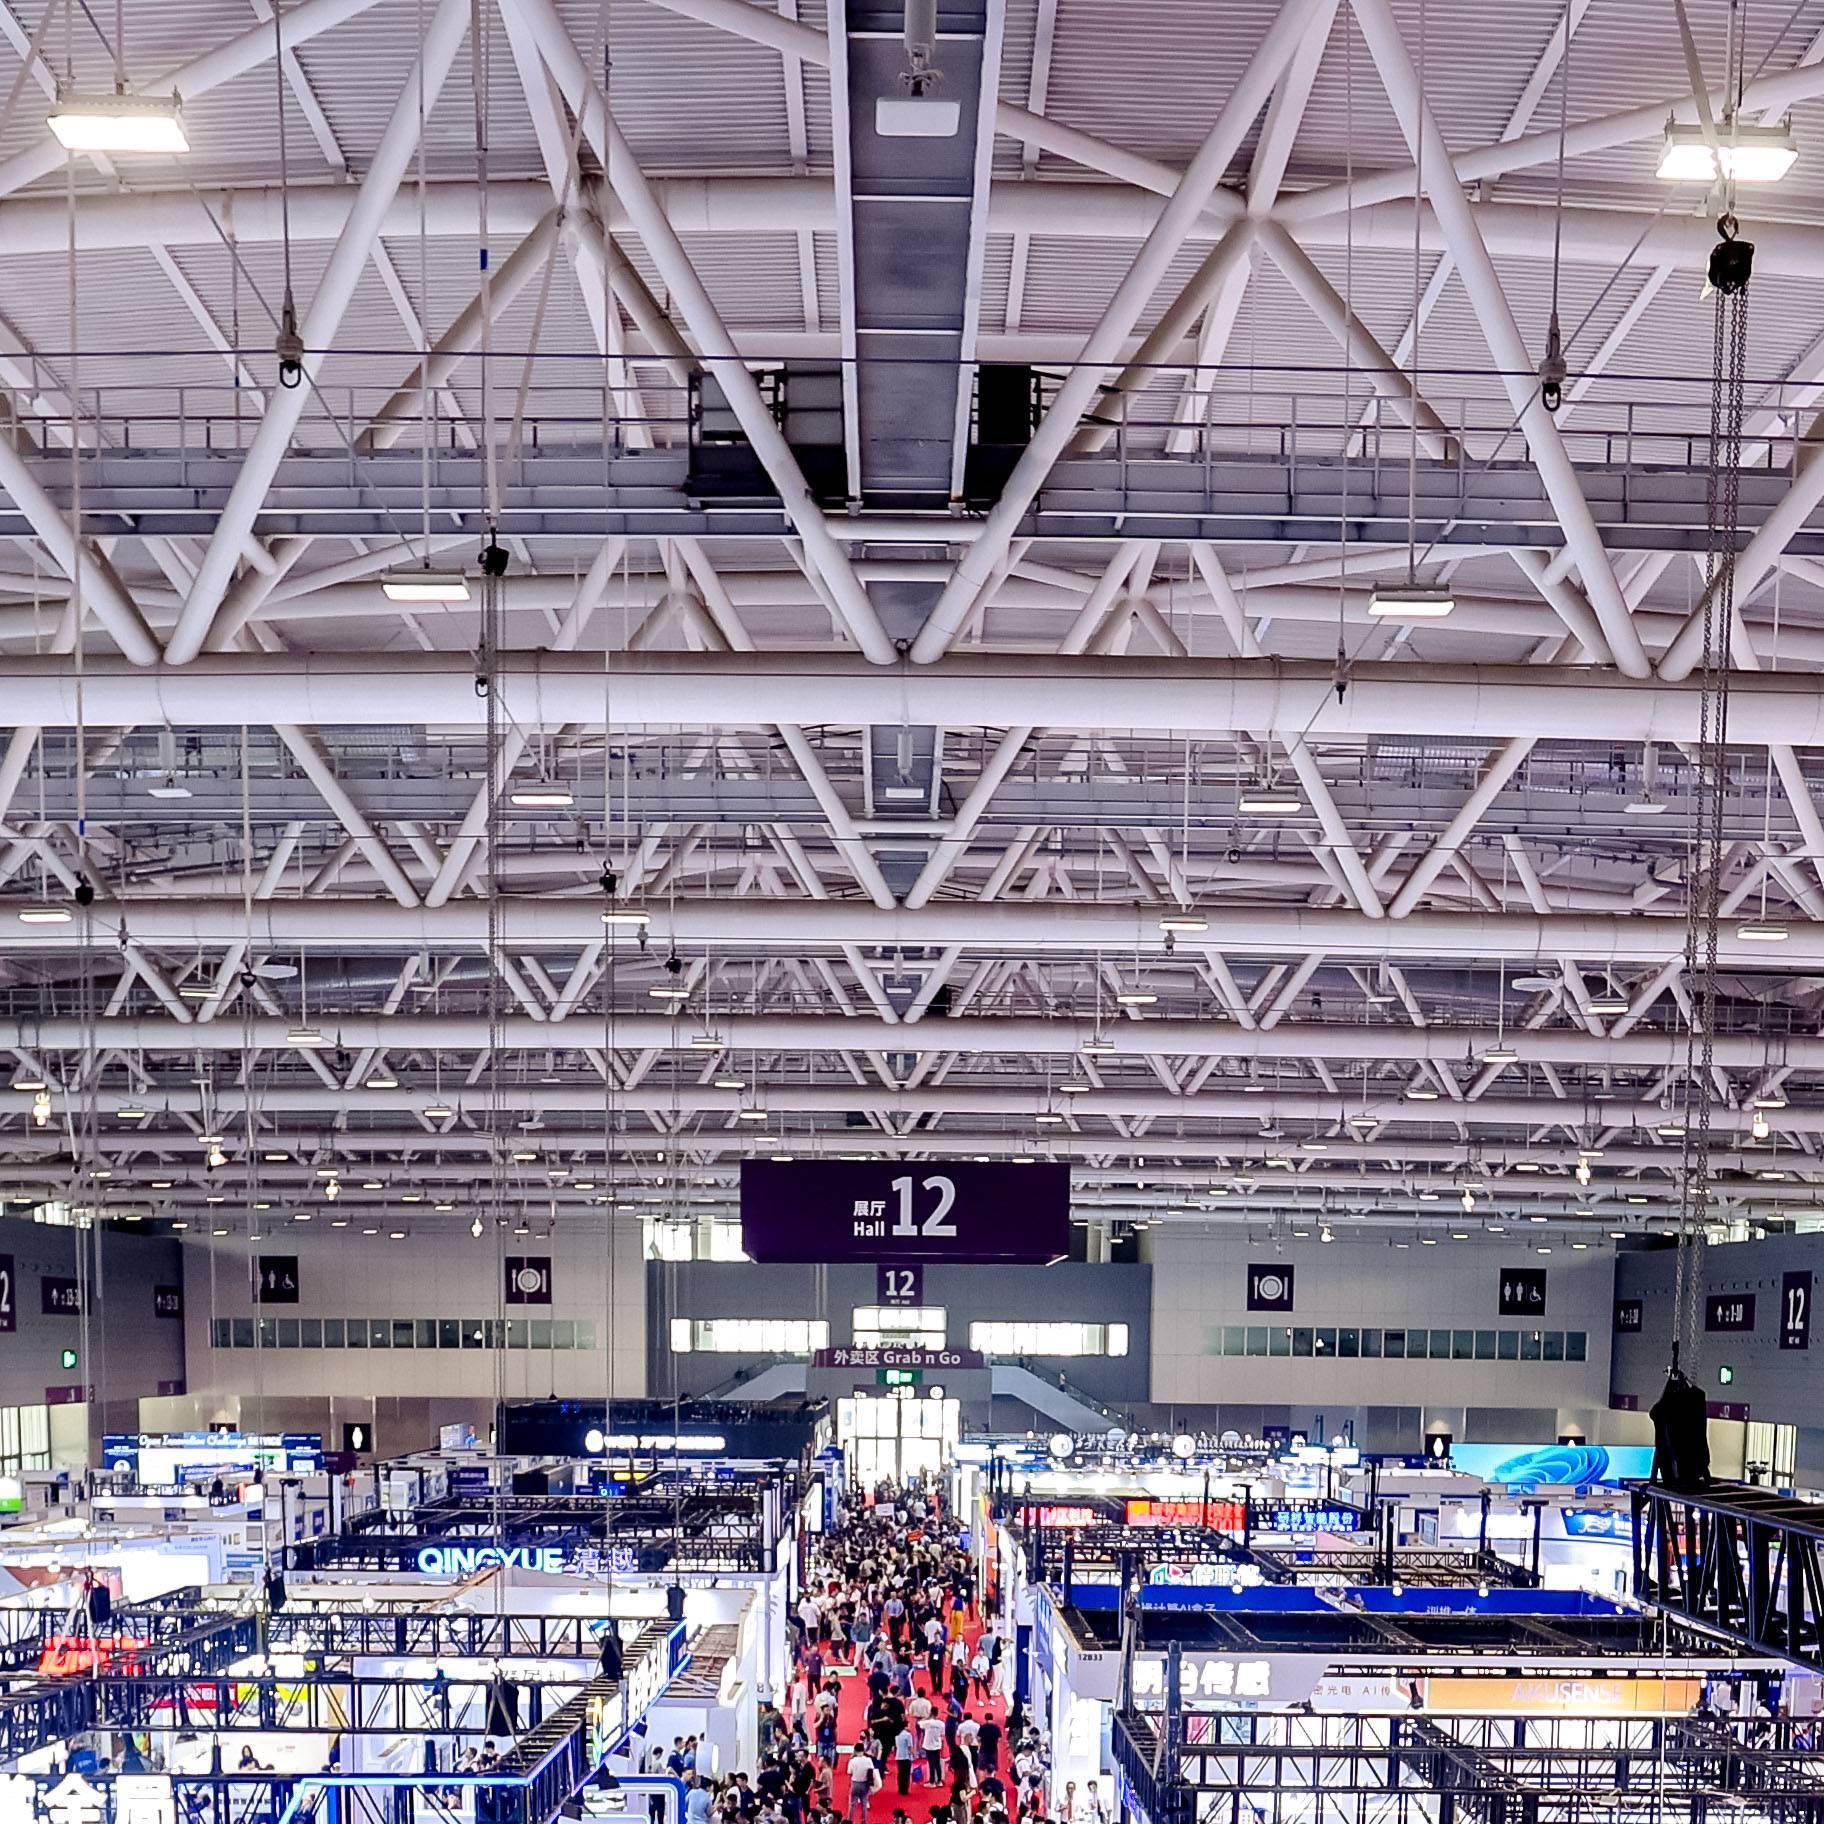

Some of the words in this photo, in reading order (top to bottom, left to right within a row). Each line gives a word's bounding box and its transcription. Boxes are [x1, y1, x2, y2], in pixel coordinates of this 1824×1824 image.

[853, 1201, 885, 1216] 展厅
[891, 1176, 956, 1236] 12
[854, 1220, 885, 1236] Hall
[886, 1270, 915, 1296] 12
[1787, 1287, 1805, 1330] 12
[834, 1350, 879, 1366] 外卖区
[883, 1351, 921, 1366] Grab
[925, 1354, 934, 1365] n
[939, 1352, 961, 1366] Go
[417, 1546, 563, 1574] QINGYUE
